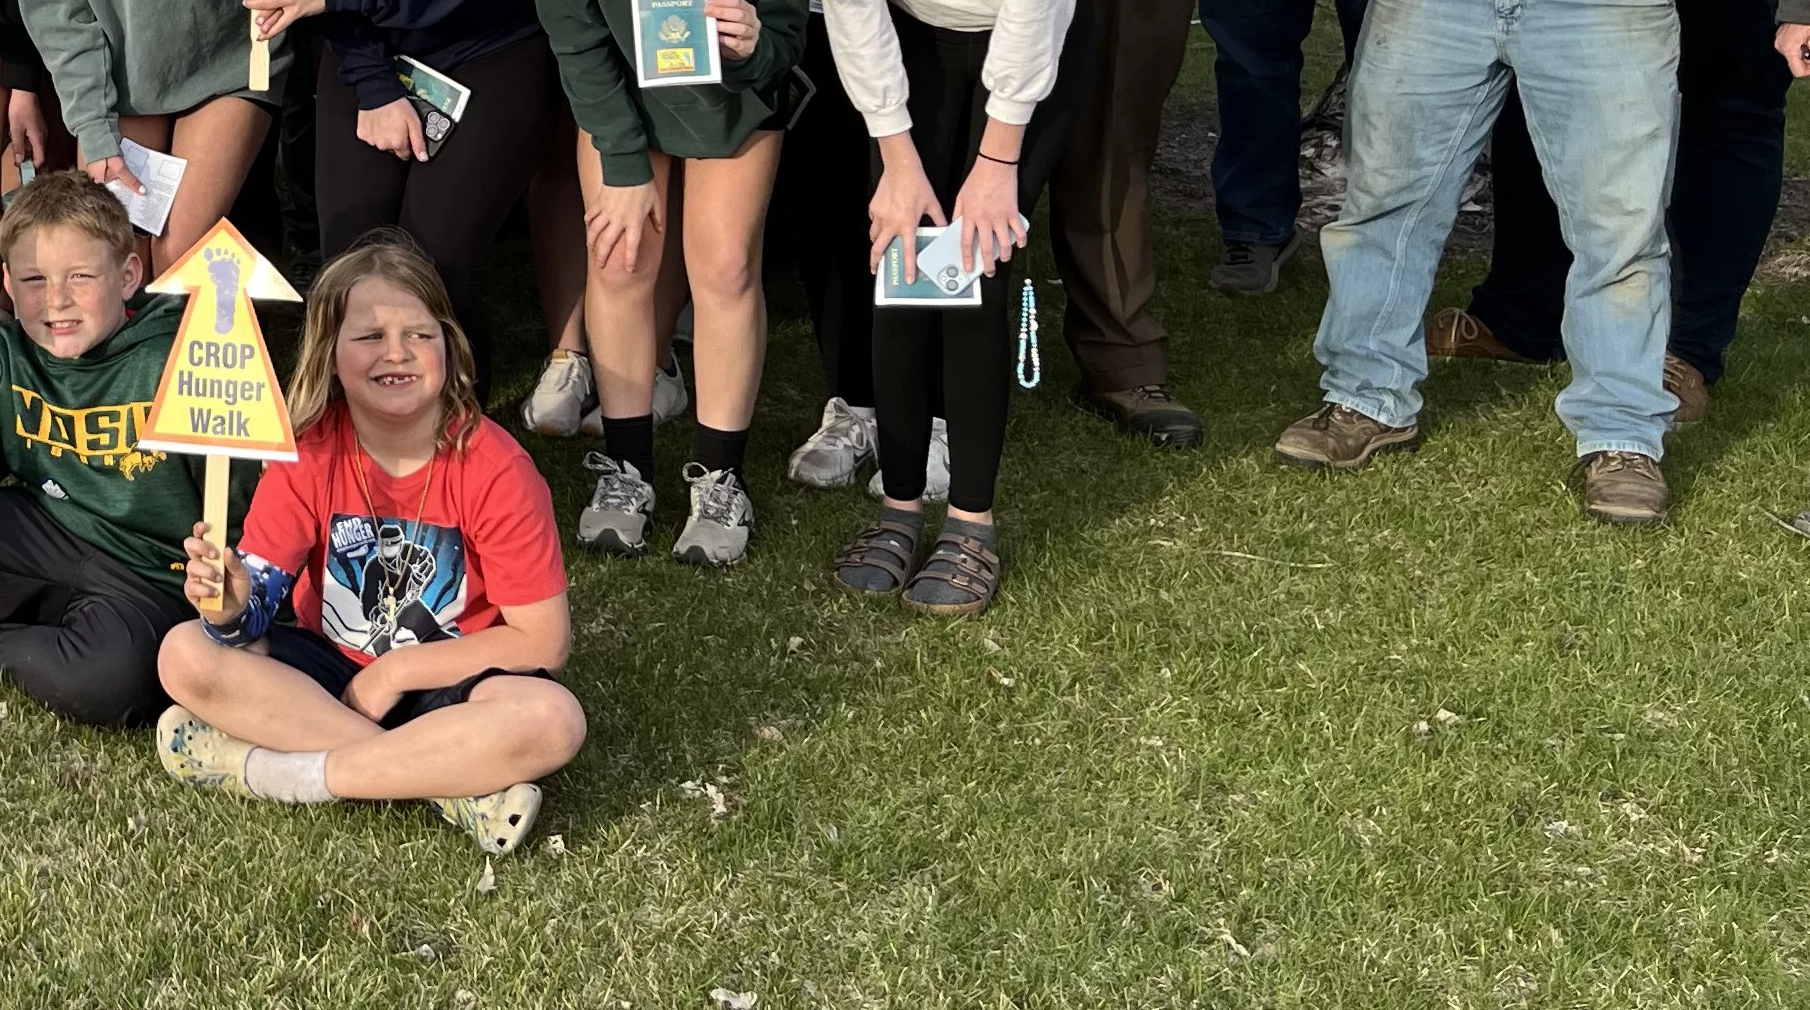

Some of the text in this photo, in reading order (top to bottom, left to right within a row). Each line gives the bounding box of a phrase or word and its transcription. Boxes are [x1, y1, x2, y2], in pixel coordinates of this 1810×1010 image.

[651, 0, 693, 8] PASSPORT
[891, 247, 900, 286] PASSPORT
[188, 341, 256, 370] CROP
[177, 370, 266, 405] Hunger
[190, 408, 251, 438] Walk
[330, 523, 375, 550] HUNGER
[336, 517, 362, 530] END
